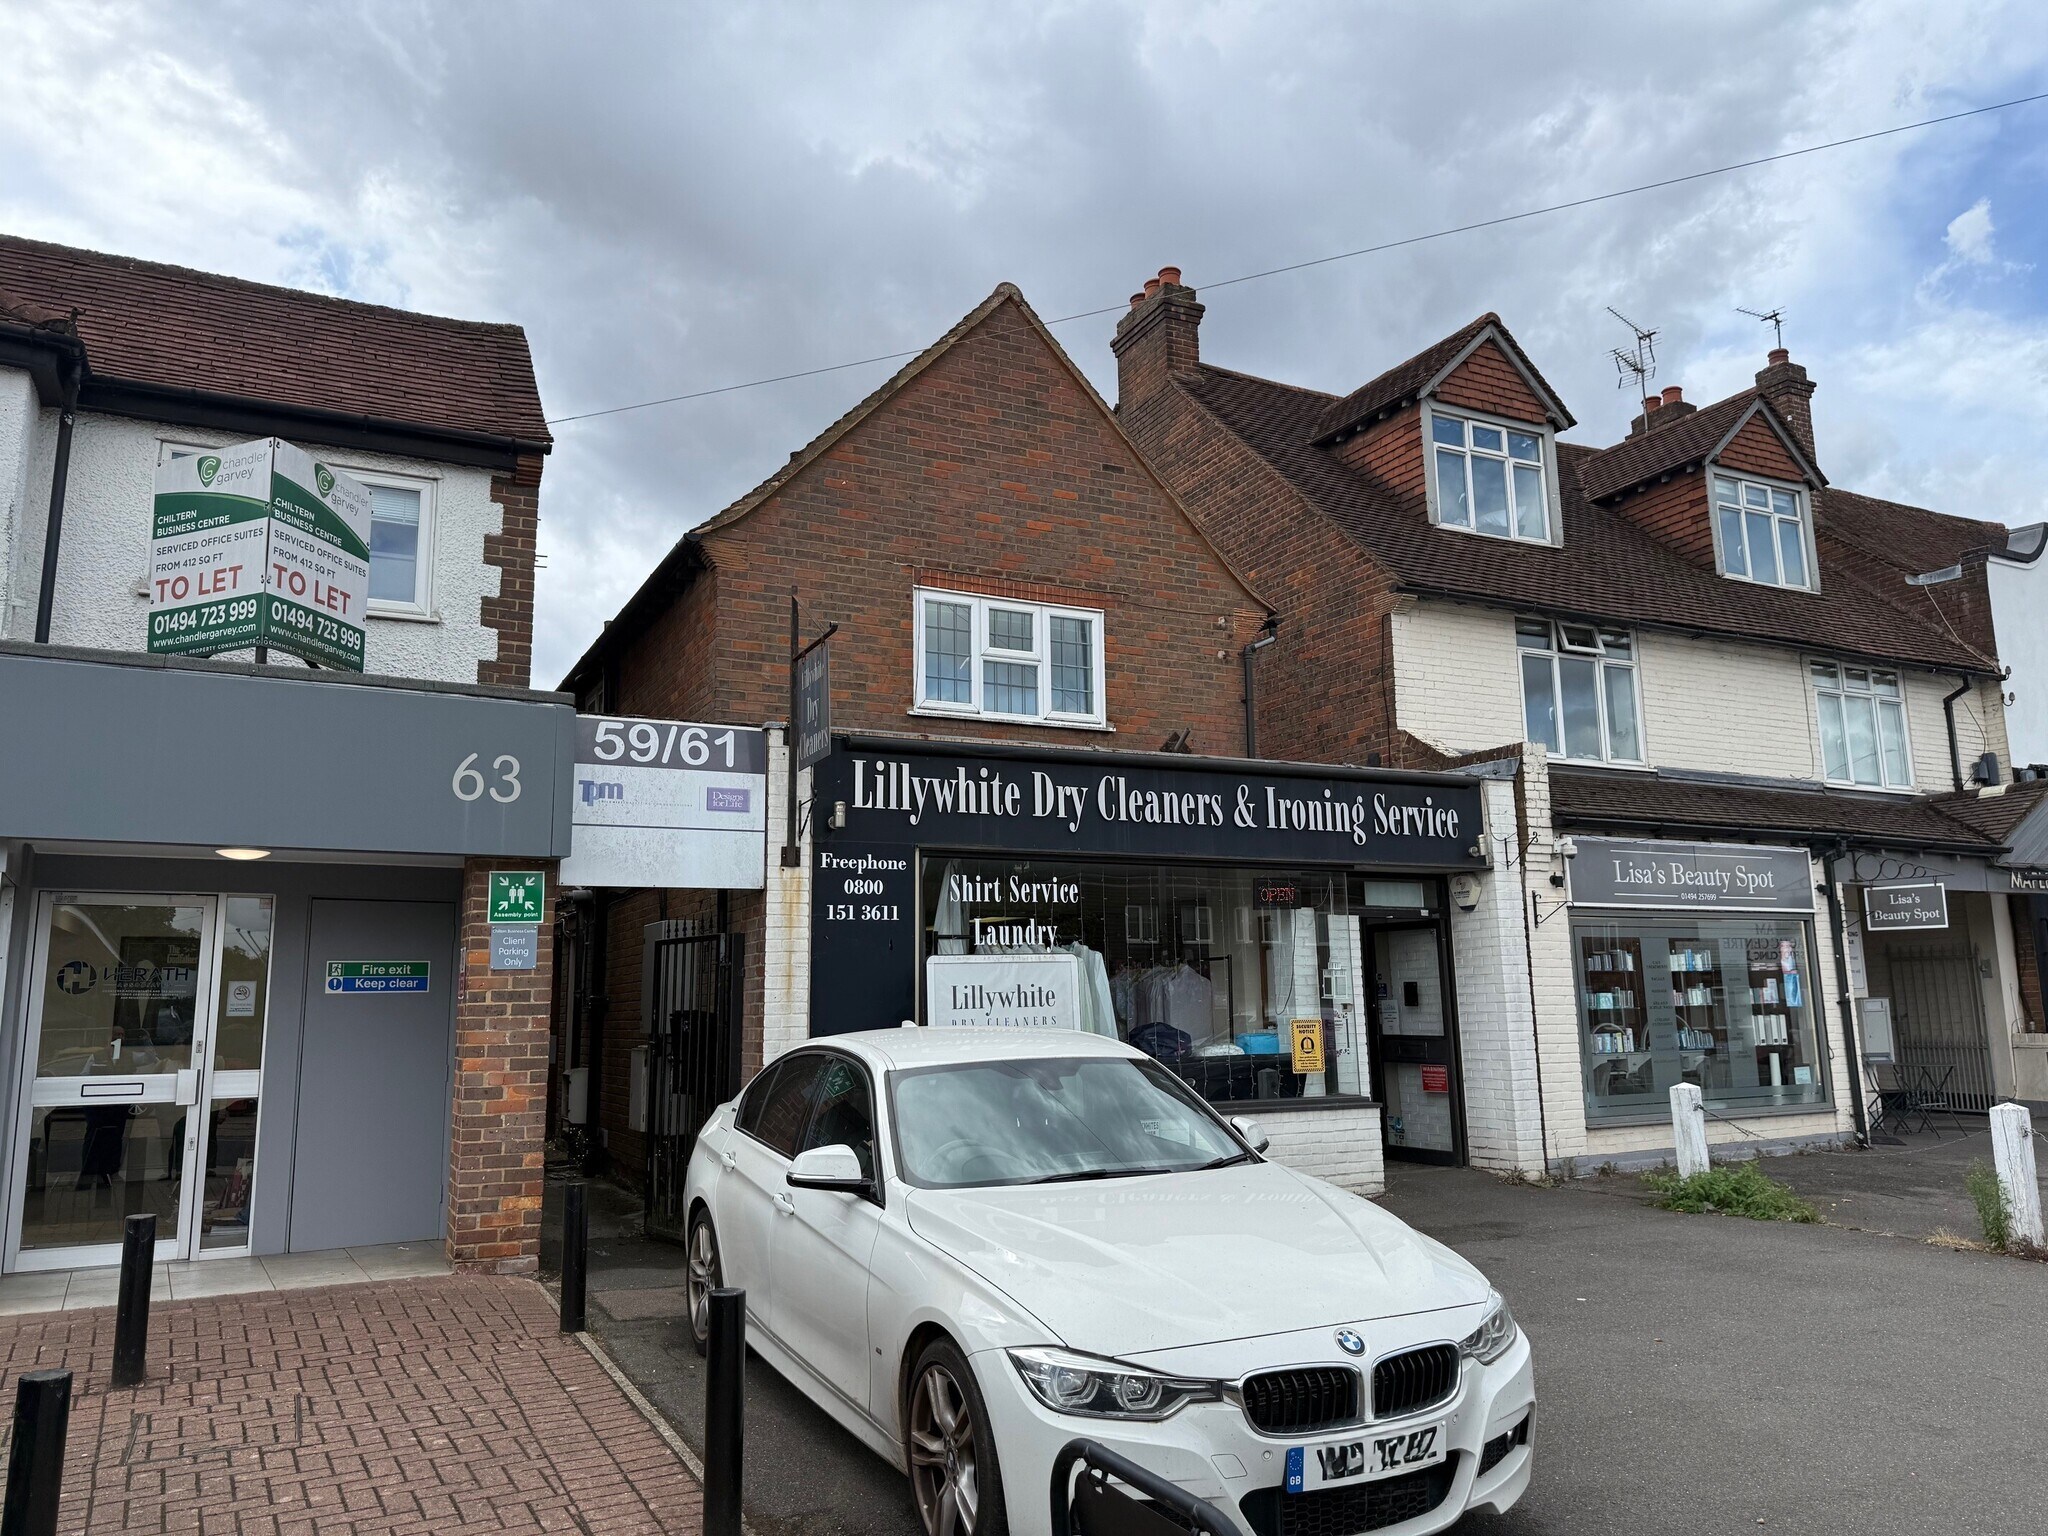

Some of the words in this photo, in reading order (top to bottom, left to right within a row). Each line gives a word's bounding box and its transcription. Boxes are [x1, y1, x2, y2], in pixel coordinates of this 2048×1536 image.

[223, 452, 267, 469] chandler
[216, 468, 254, 485] garvey
[331, 493, 359, 516] garvey
[336, 483, 368, 507] chandler
[157, 510, 197, 524] CHILTERN
[275, 497, 315, 521] CHILTERN
[157, 522, 196, 536] BUSINESS
[198, 515, 230, 528] CENTRE
[274, 509, 314, 532] BUSINESS
[315, 527, 342, 546] CENTRE
[156, 541, 198, 556] SERVICED
[201, 534, 232, 547] OFFICE
[234, 527, 264, 541] SUITES
[155, 560, 180, 572] FROM
[183, 558, 196, 567] 412
[199, 556, 211, 564] SQ
[213, 553, 223, 562] FT
[273, 547, 298, 563] FROM
[300, 557, 313, 569] 412
[314, 564, 325, 575] SQ
[327, 569, 336, 579] FT
[274, 530, 315, 552] SERVICED
[317, 548, 342, 566] OFFICE
[344, 561, 367, 578] SUITES
[156, 576, 189, 603] TO
[198, 565, 243, 596] LET
[273, 563, 306, 596] TO
[314, 580, 351, 615] LET
[154, 609, 197, 634] 01494
[201, 604, 226, 626] 723
[229, 599, 257, 621] 999
[272, 601, 314, 632] 01494
[317, 617, 338, 641] 723
[341, 627, 361, 650] 999
[153, 623, 256, 648] www.chandlergarvey.com
[270, 625, 360, 663] www.chandlergarvey.com
[807, 697, 819, 727] Dry
[593, 721, 735, 768] 59/61
[800, 726, 828, 761] Cleaners
[451, 752, 522, 803] 63
[712, 792, 744, 801] Designs
[725, 800, 742, 808] Life
[851, 759, 1021, 826] Lillywhite
[1031, 771, 1088, 833] Dry
[1097, 775, 1224, 827] Cleaners
[1232, 784, 1258, 828] &
[1264, 786, 1367, 846] Ironing
[1374, 793, 1460, 839] Service
[820, 852, 907, 874] Freephone
[844, 879, 884, 894] 0800
[1612, 860, 1666, 884] Lisa's
[1670, 862, 1730, 893] Beauty
[1735, 865, 1775, 893] Spot
[950, 874, 1001, 902] Shirt
[1009, 875, 1079, 903] Service
[1261, 888, 1295, 901] OPEN
[1889, 893, 1920, 905] Lisa's
[826, 904, 855, 920] 151
[861, 905, 899, 920] 3611
[1874, 910, 1911, 922] Beauty
[1914, 908, 1940, 921] Spot
[974, 918, 1058, 953] Laundry
[499, 948, 528, 957] Parking
[504, 958, 522, 967] Only
[104, 967, 188, 981] HERATH
[362, 965, 385, 974] Fire
[389, 965, 411, 974] exit
[355, 979, 385, 990] Keep
[389, 979, 418, 988] clear
[952, 984, 1056, 1016] Lillywhite
[988, 1016, 1057, 1027] CLEANERS
[1290, 1476, 1301, 1485] GB
